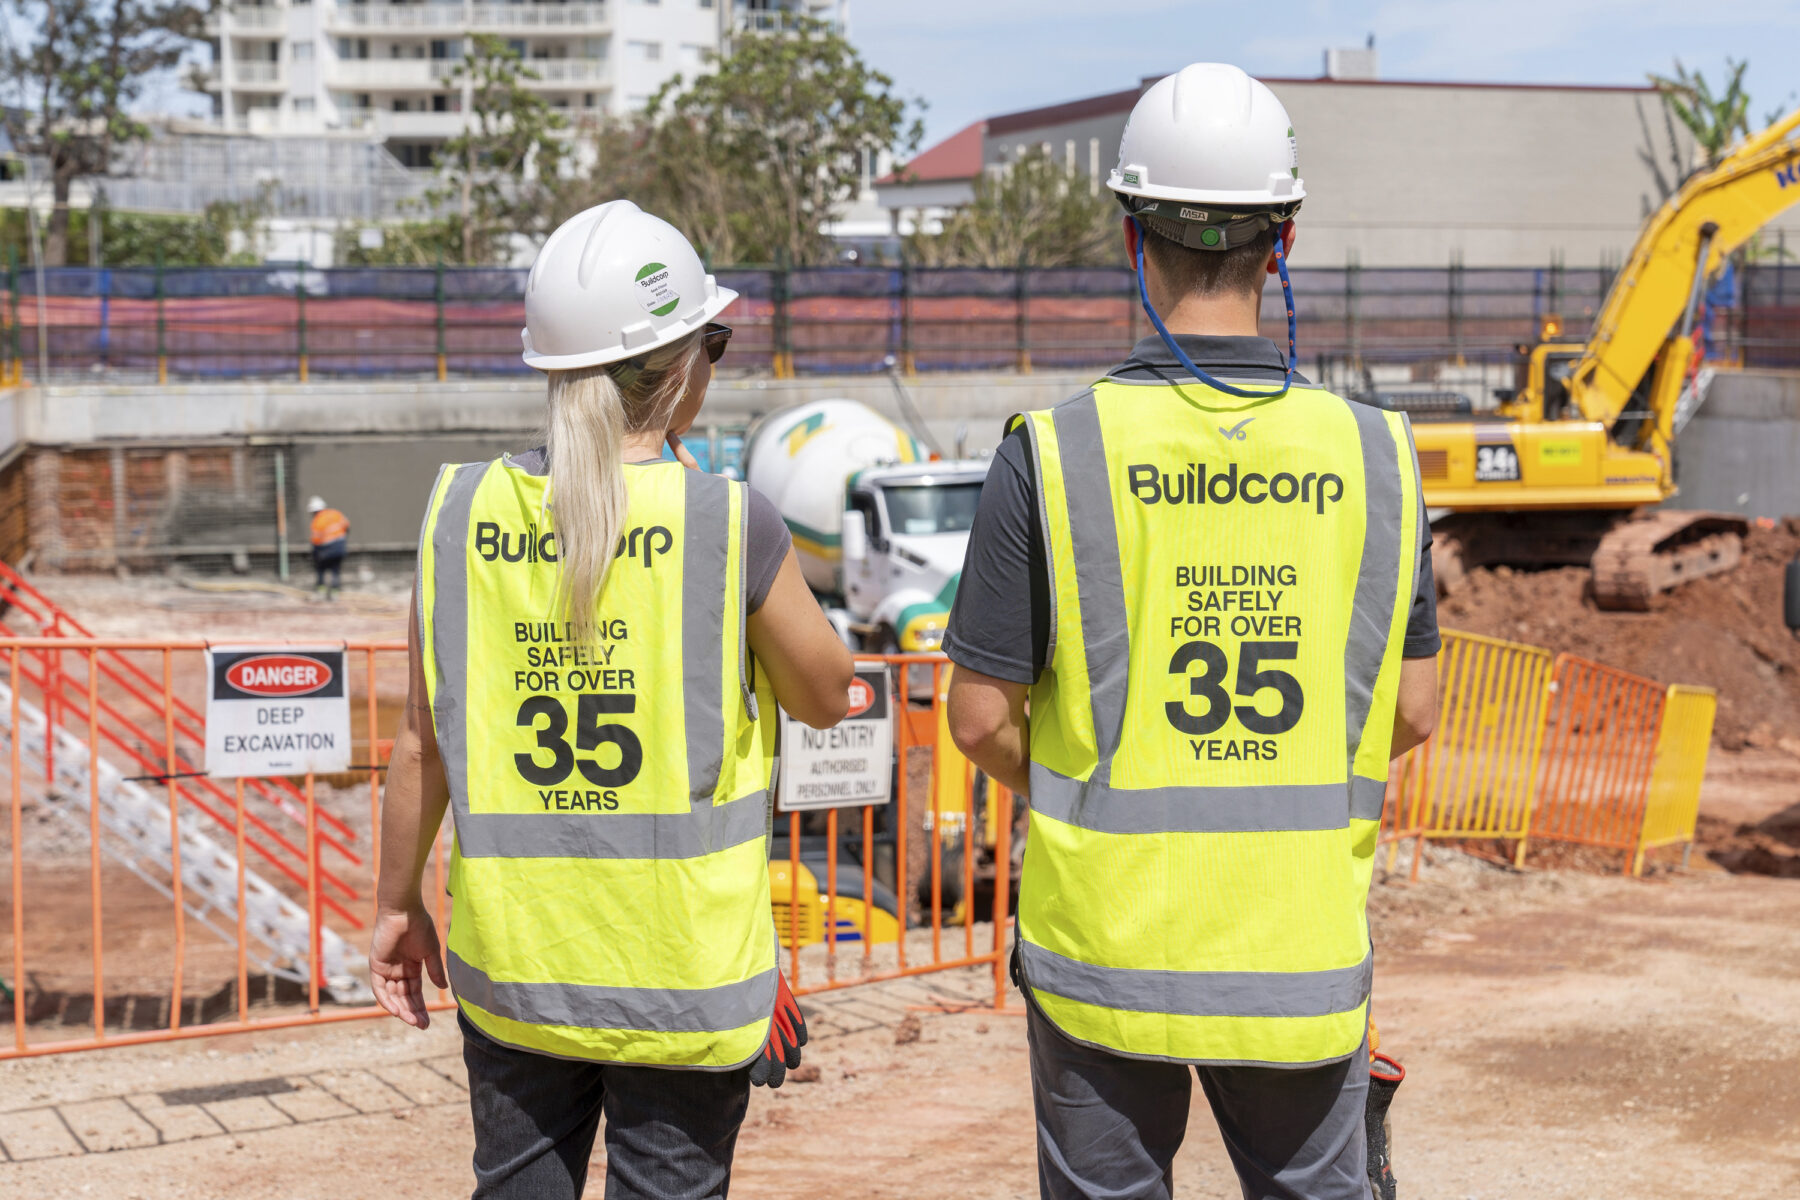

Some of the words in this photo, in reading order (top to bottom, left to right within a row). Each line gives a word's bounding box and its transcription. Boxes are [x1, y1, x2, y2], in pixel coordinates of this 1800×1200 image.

[1124, 174, 1138, 184] MSA
[1182, 208, 1208, 221] MSA
[1128, 463, 1344, 515] Buildcorp
[1176, 565, 1297, 587] BUILDING
[1187, 590, 1284, 612] SAFELY
[1170, 615, 1221, 637] FOR
[1230, 615, 1302, 637] OVER
[241, 665, 318, 687] DANGER
[514, 670, 560, 691] FOR
[567, 669, 636, 691] OVER
[1164, 640, 1305, 735] 35
[257, 706, 304, 725] DEEP
[223, 732, 335, 753] EXCAVATION
[513, 693, 643, 788] 35
[829, 725, 877, 749] ENTRY
[1189, 739, 1278, 761] YEARS
[538, 790, 620, 811] YEARS
